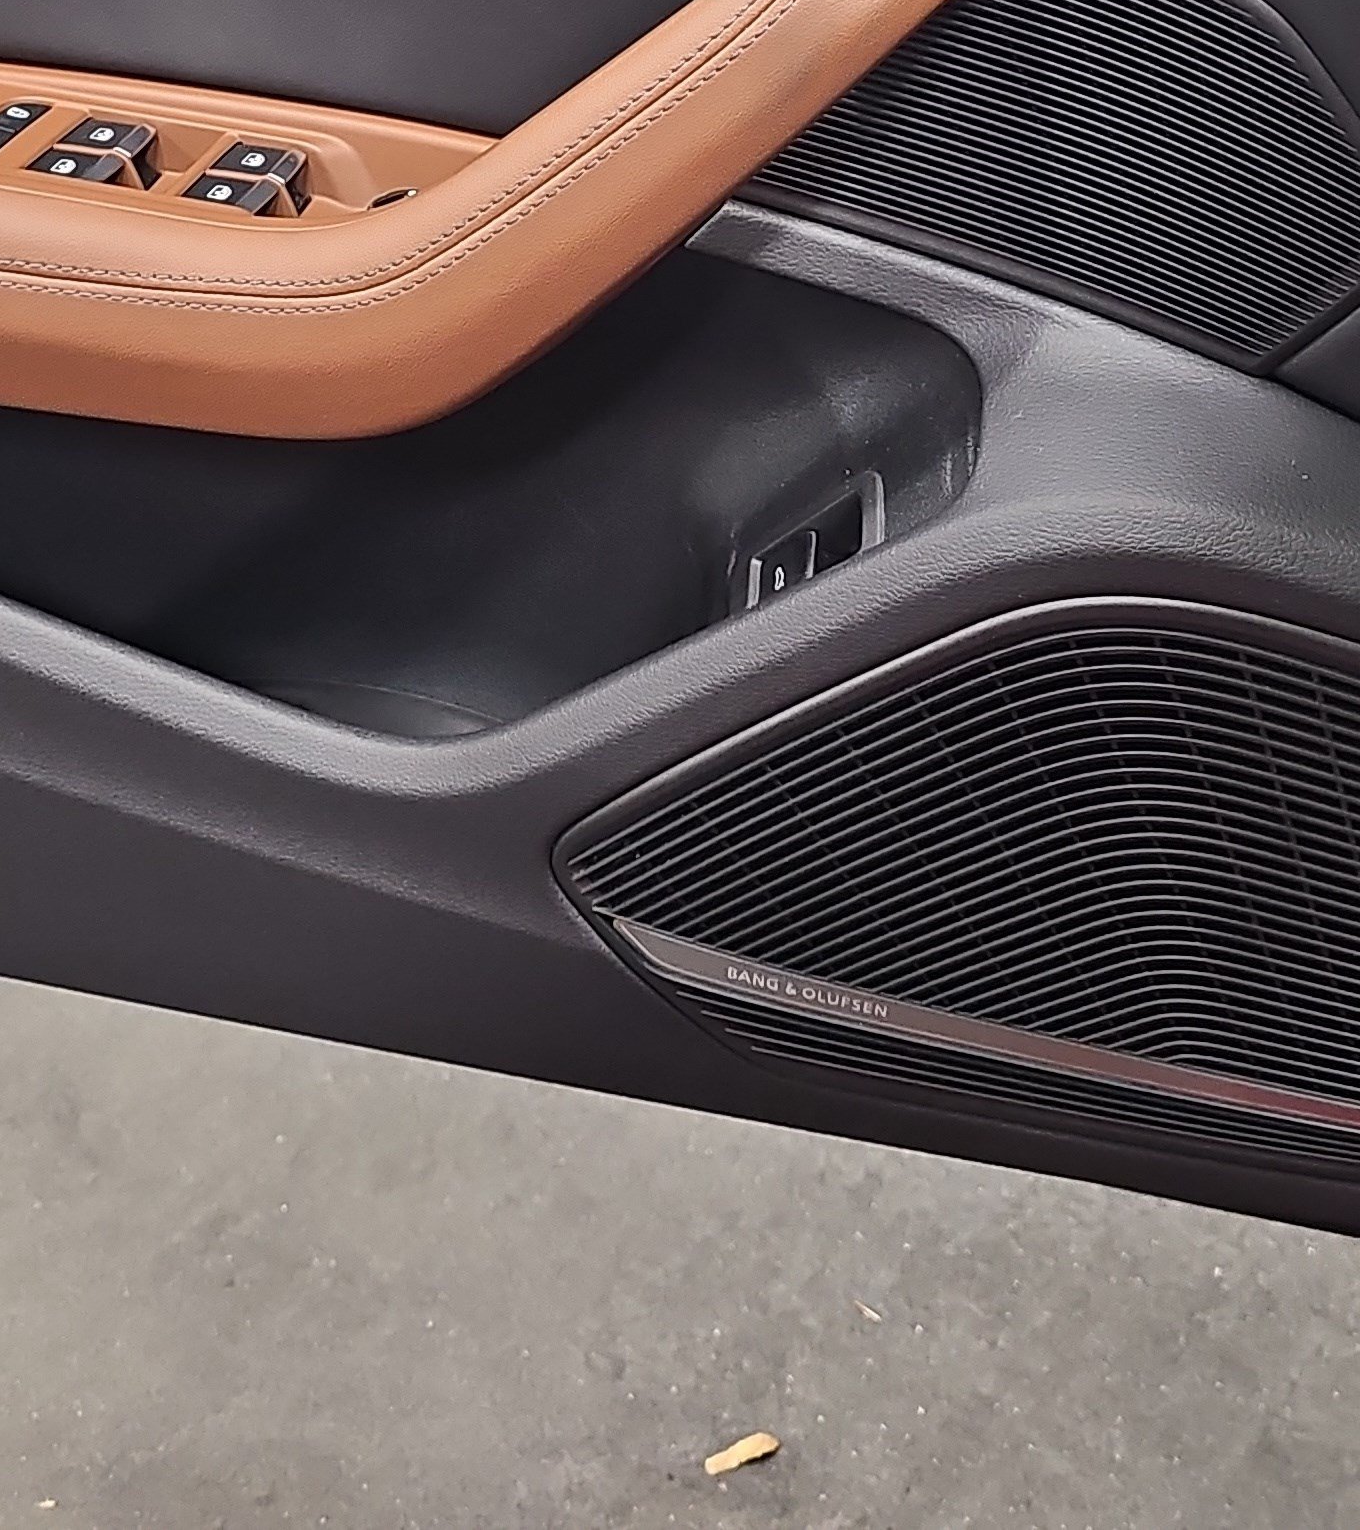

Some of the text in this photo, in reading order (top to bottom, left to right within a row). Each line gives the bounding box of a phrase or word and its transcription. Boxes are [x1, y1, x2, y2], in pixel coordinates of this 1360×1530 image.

[727, 966, 888, 1018] BANG & OLUFSEN
